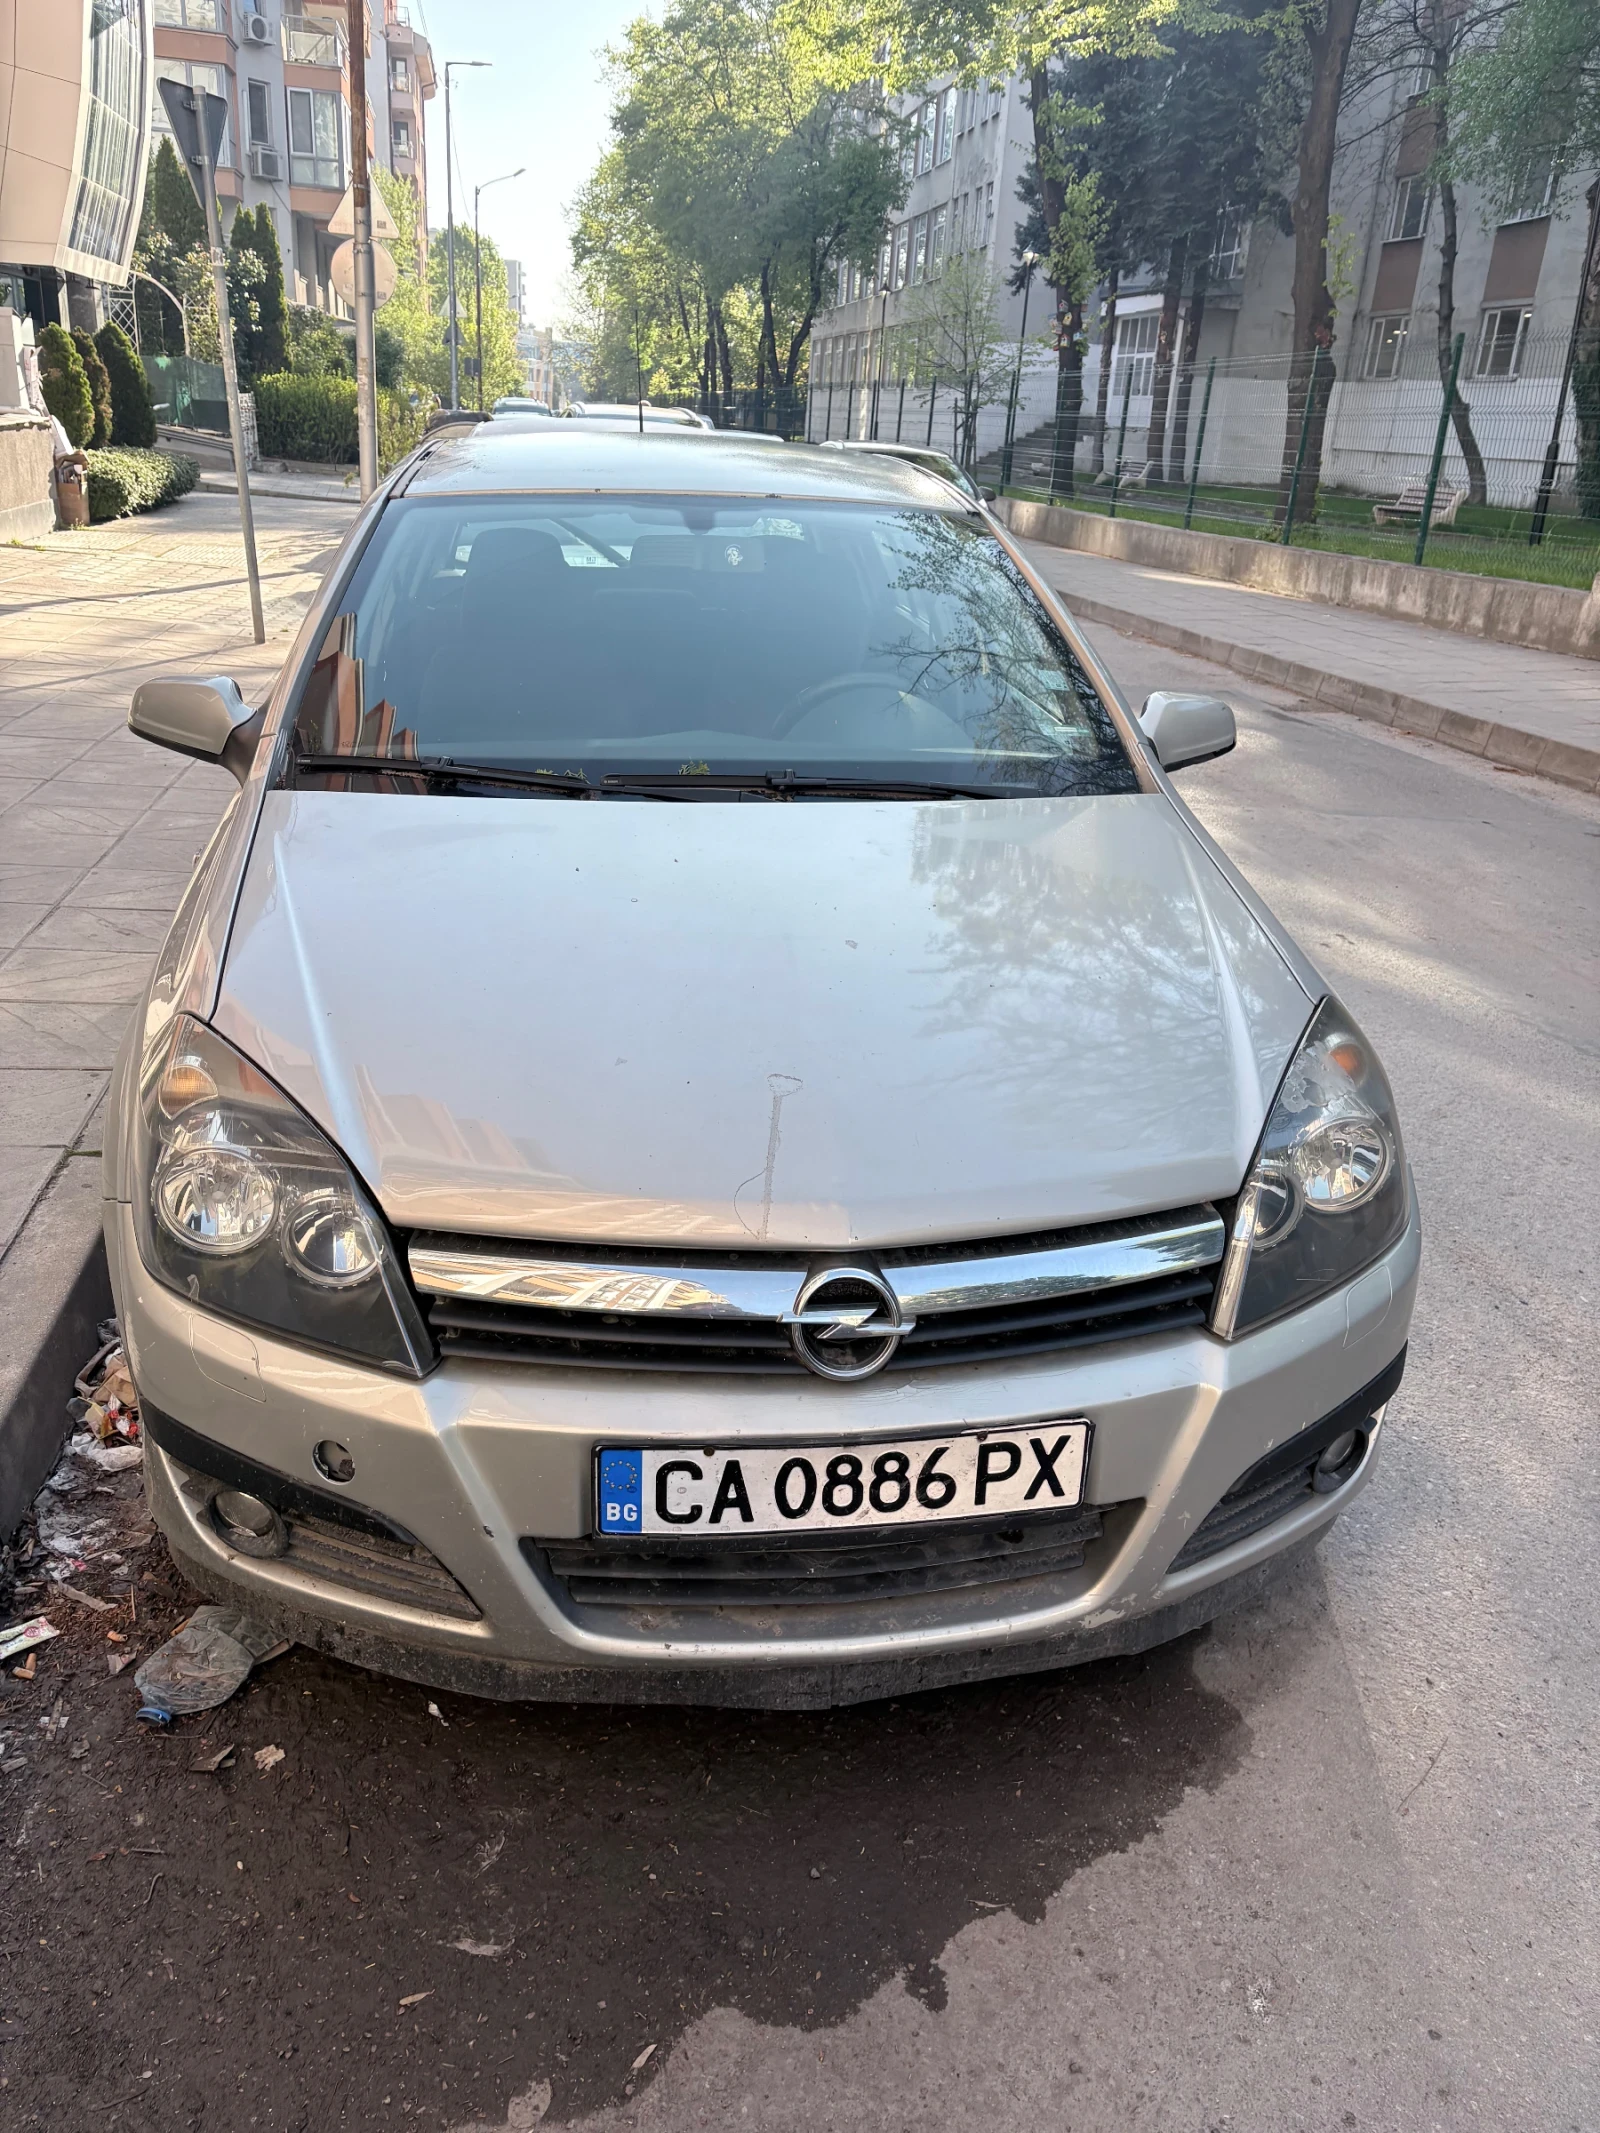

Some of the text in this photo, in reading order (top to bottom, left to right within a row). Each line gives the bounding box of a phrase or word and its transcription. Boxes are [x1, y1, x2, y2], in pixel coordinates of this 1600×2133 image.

[656, 1434, 1072, 1524] CA 0886 PX
[606, 1502, 638, 1522] BG
